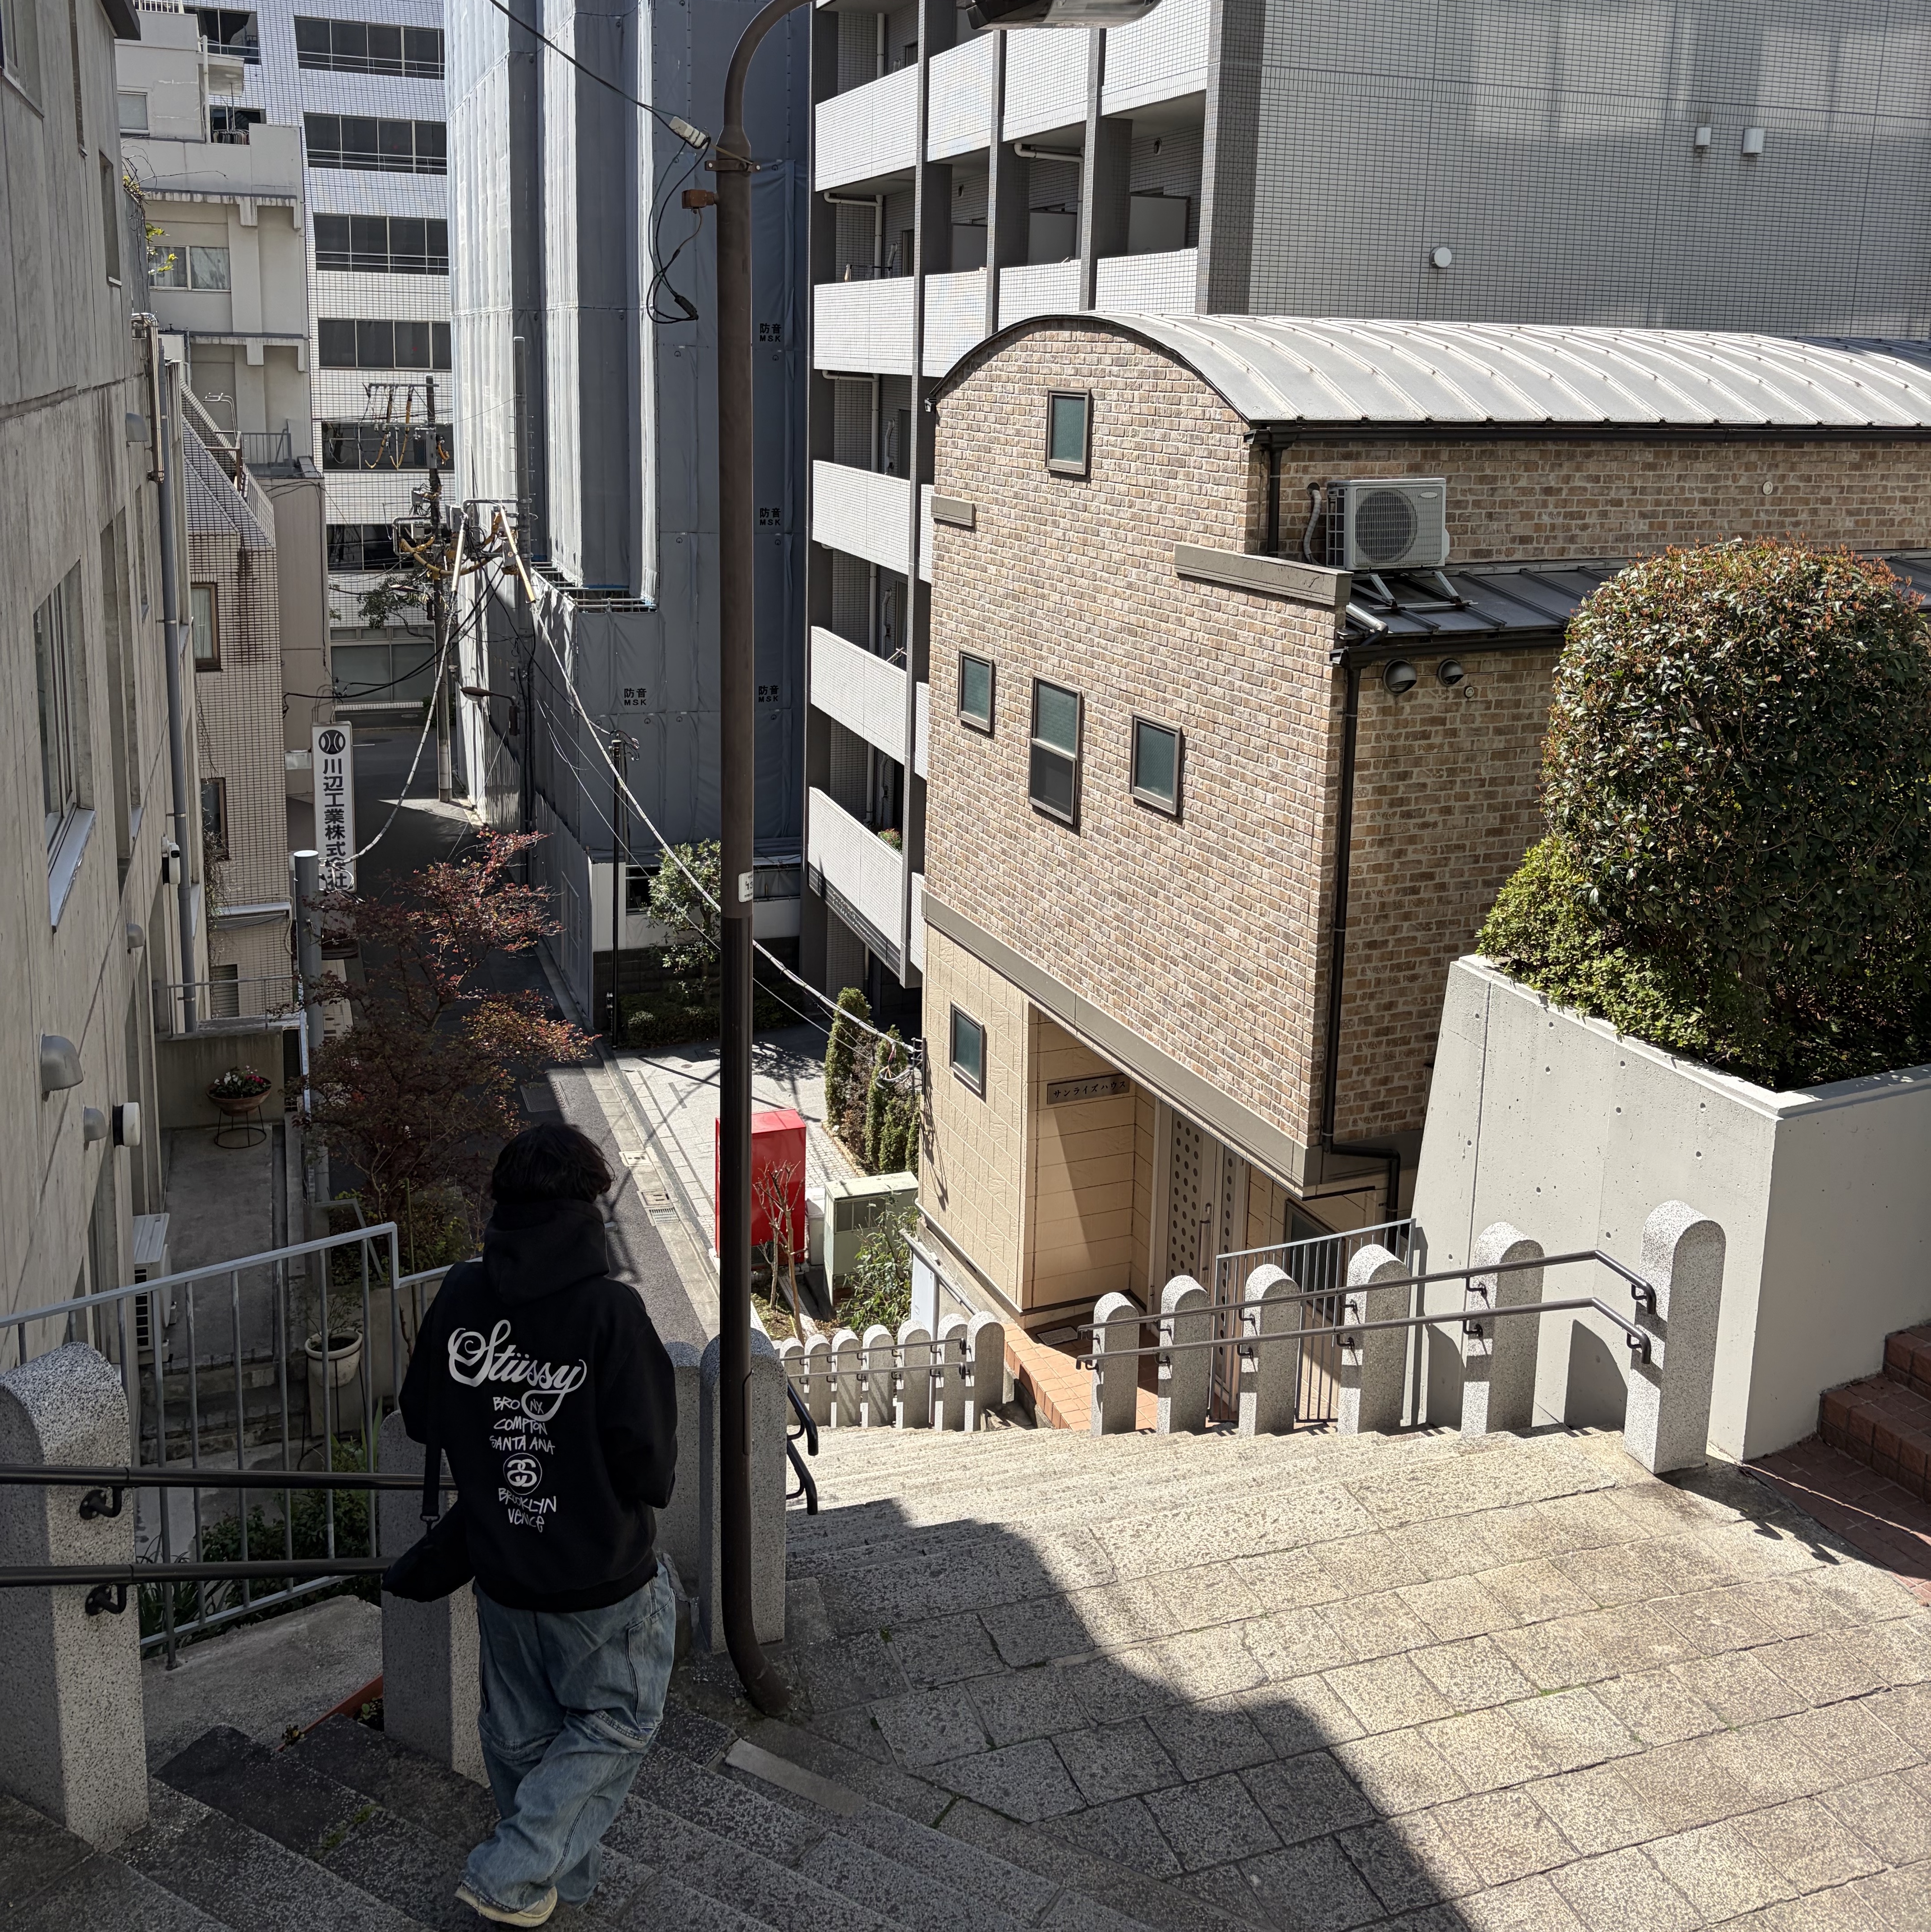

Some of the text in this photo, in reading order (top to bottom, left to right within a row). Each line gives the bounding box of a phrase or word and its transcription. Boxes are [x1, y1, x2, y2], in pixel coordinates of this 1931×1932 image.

[760, 323, 781, 334] 防音
[760, 508, 780, 518] 防音
[624, 688, 647, 698] 防音
[758, 685, 779, 695] 防音
[1054, 1081, 1125, 1098] サンライズハウス
[448, 1320, 587, 1422] Stüssy
[494, 1416, 547, 1435] COMPTON
[489, 1435, 555, 1455] SANTA ANA
[498, 1487, 556, 1514] BROOKLYN
